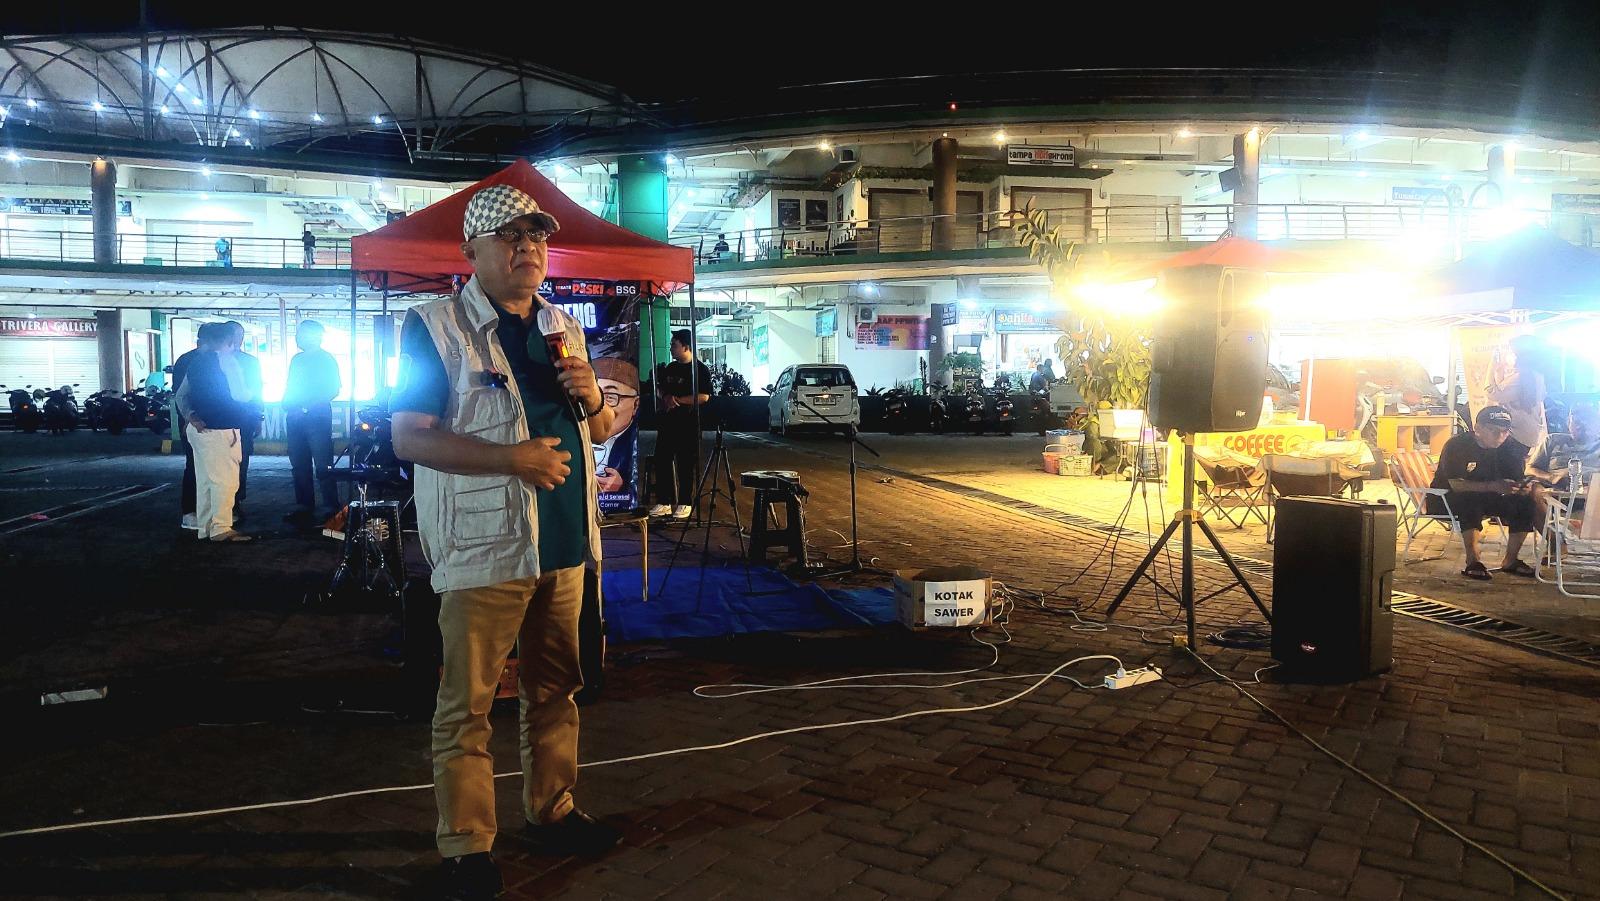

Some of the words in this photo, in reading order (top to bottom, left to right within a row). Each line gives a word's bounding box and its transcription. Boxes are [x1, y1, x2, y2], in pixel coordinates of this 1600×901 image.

[616, 285, 636, 294] BSG
[1, 320, 49, 331] TRIVERA
[53, 320, 98, 331] GALLERY
[1223, 434, 1284, 458] COFFEE
[934, 591, 974, 601] KOTAK
[934, 607, 974, 617] SAWER
